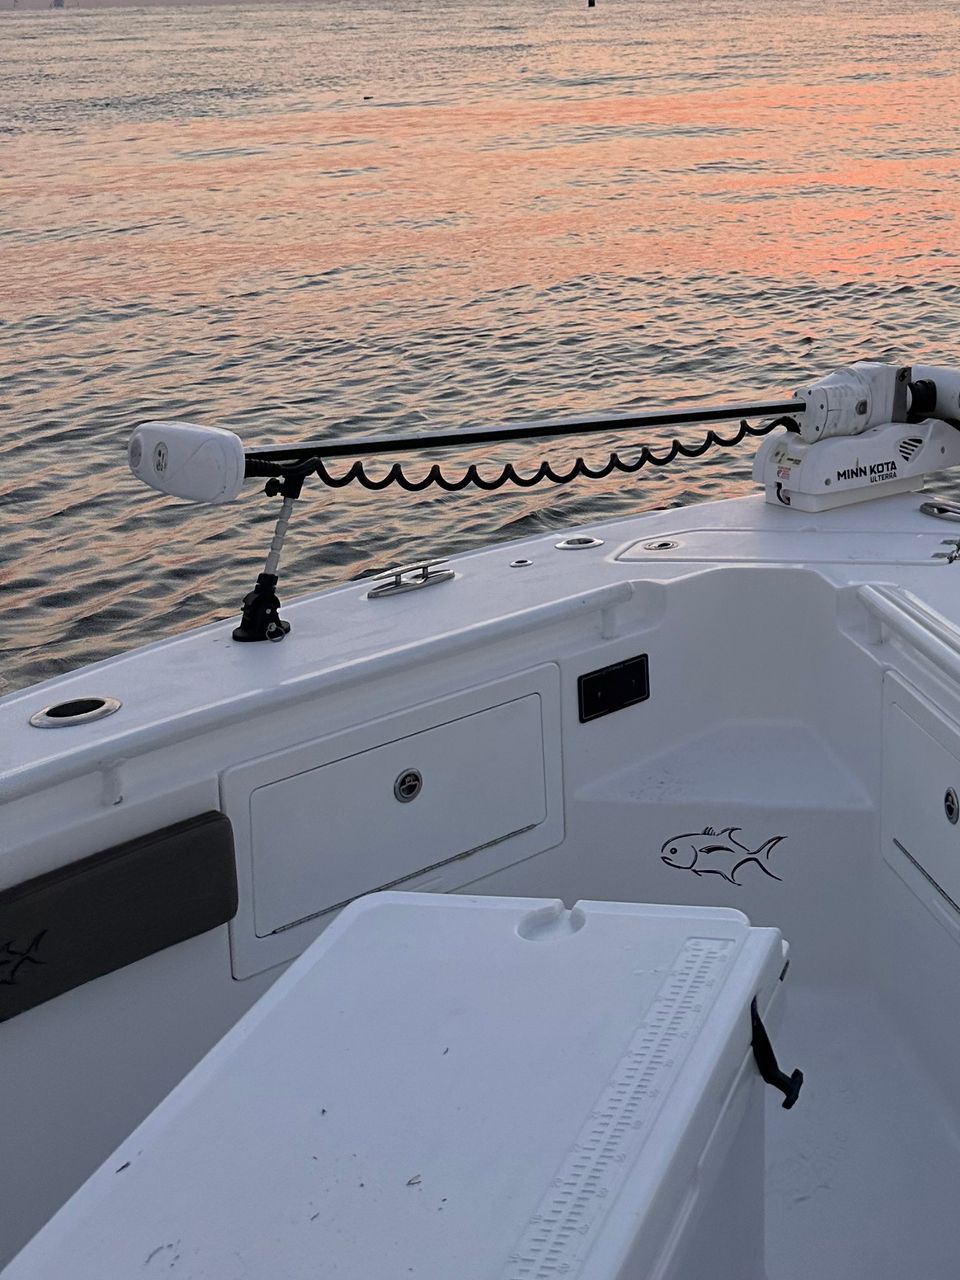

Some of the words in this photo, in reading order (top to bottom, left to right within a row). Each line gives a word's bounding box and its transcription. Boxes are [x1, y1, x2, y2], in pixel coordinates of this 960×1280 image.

[837, 466, 868, 481] MINN
[869, 460, 897, 476] KOTA
[870, 472, 897, 483] ULTERRA
